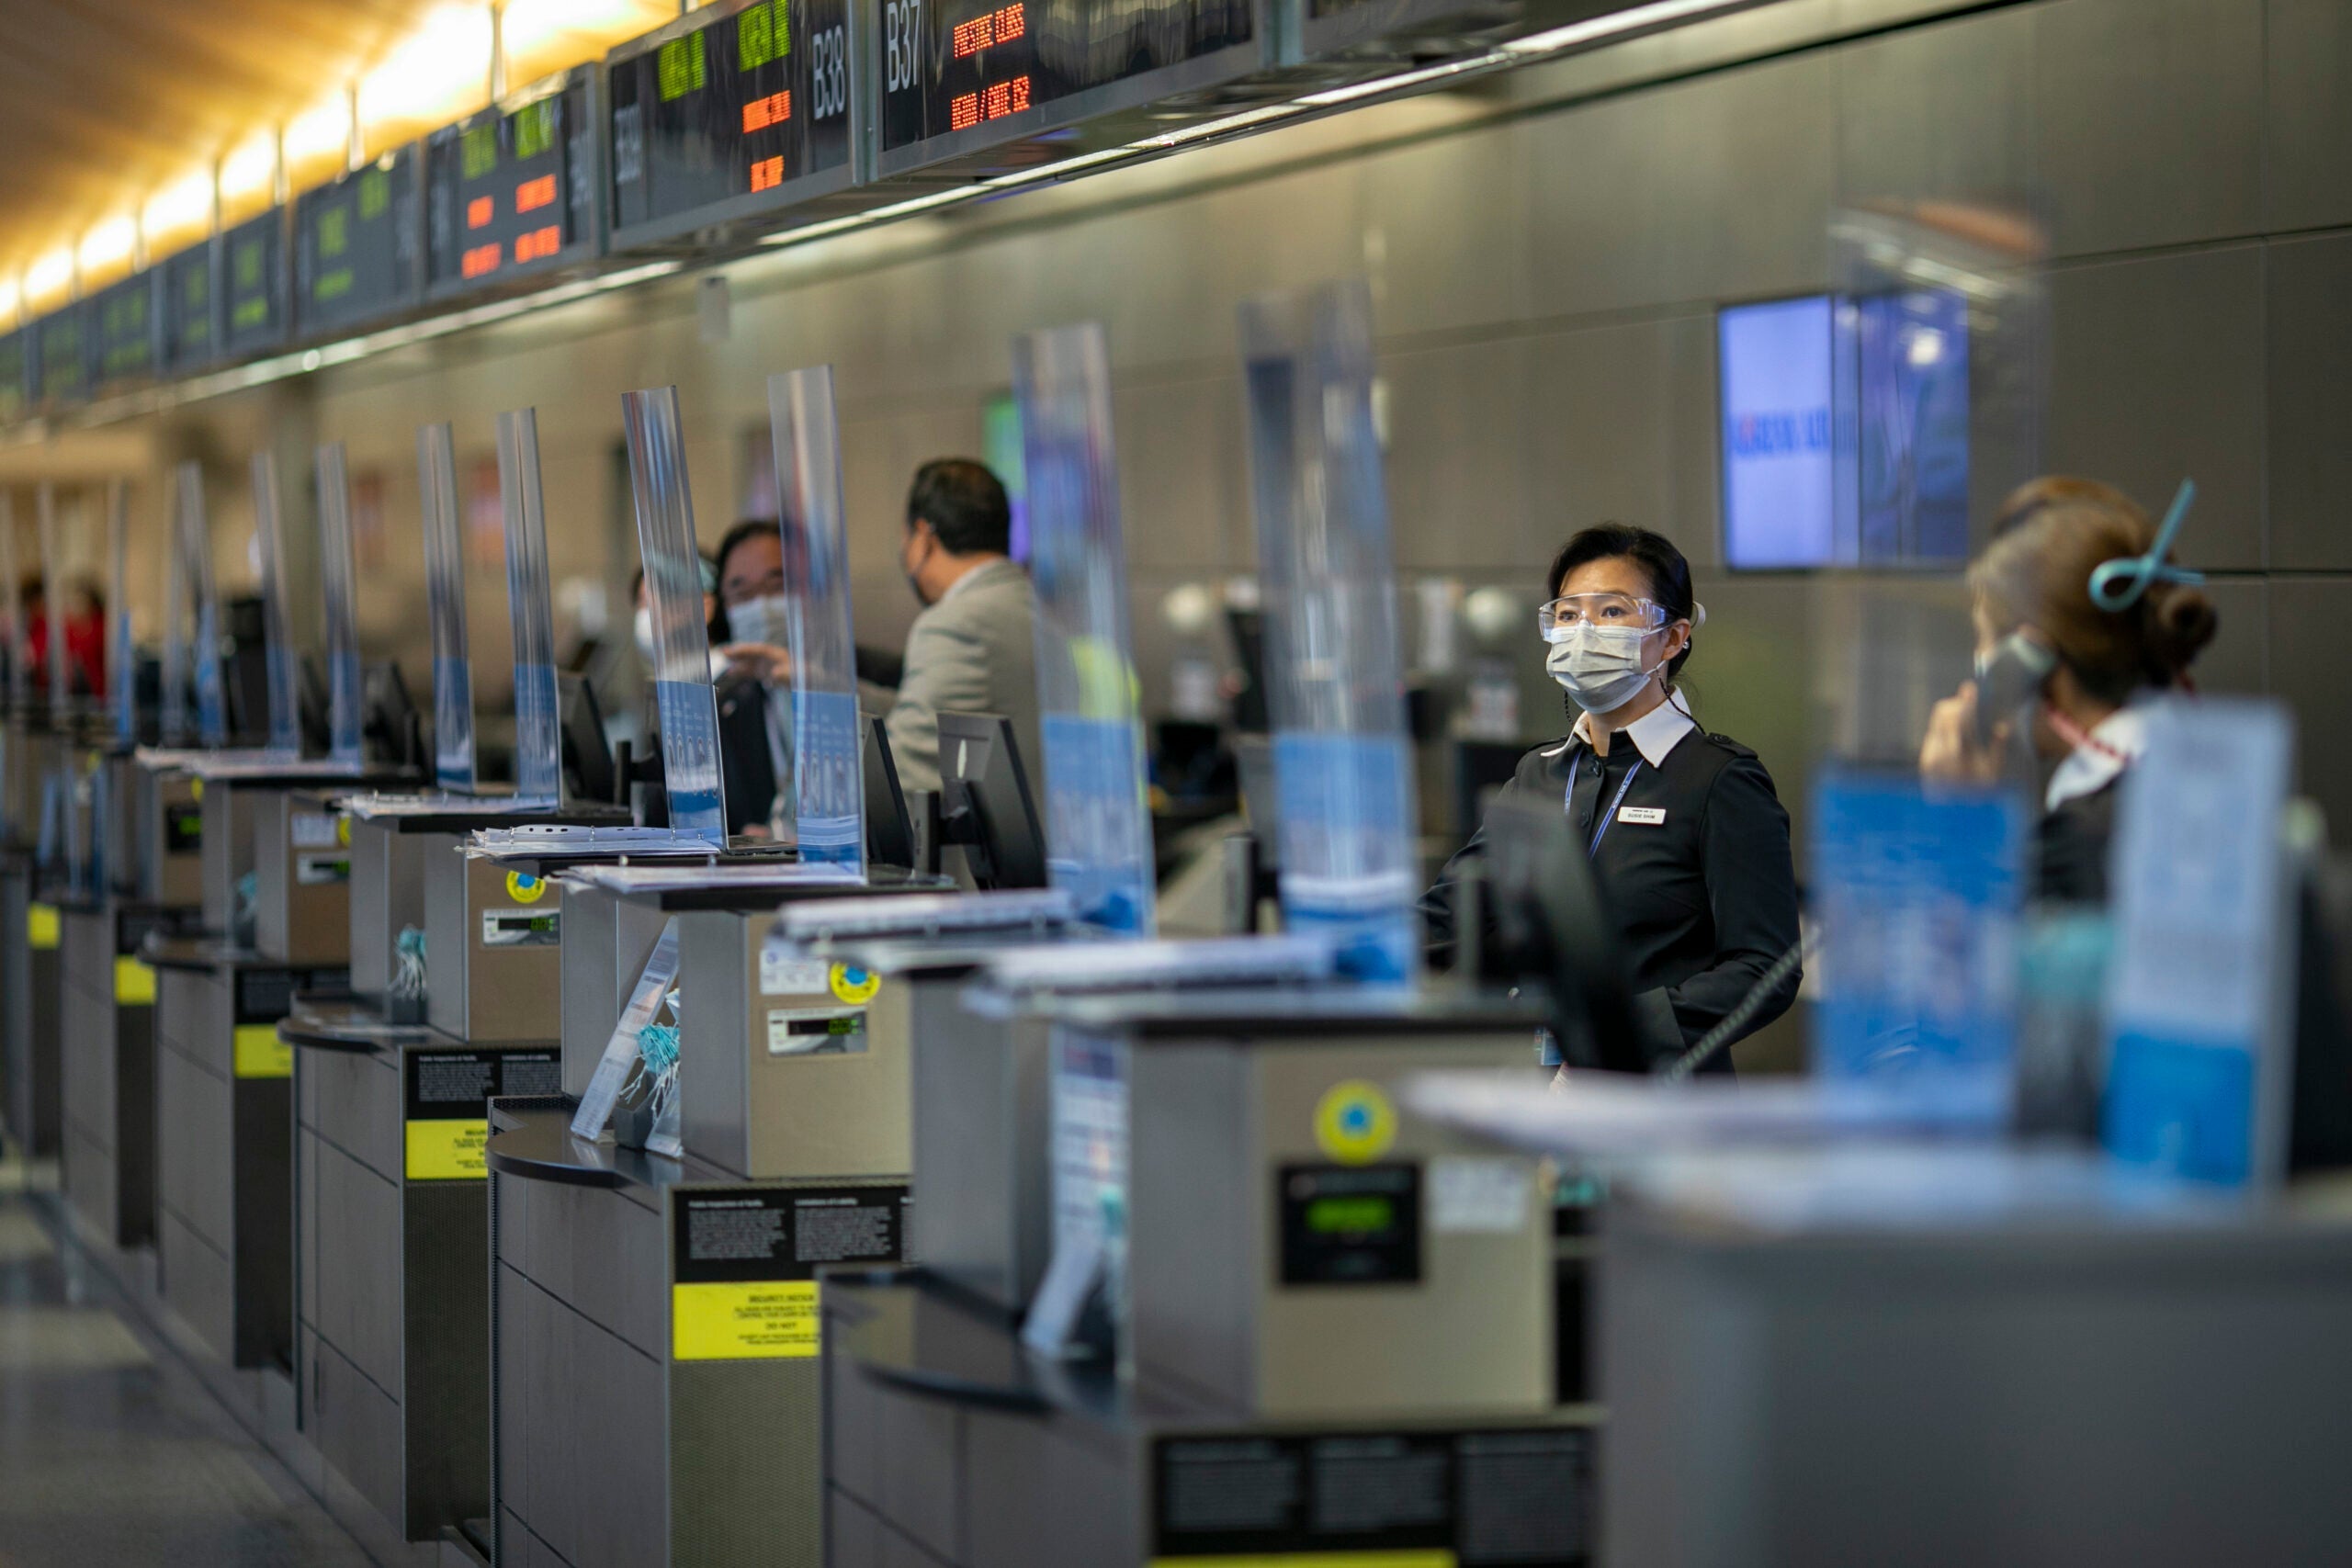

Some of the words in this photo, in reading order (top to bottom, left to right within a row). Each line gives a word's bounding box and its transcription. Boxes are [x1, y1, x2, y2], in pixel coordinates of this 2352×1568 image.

[812, 24, 846, 120] B38
[888, 0, 921, 93] B37
[749, 1294, 784, 1303] SECURITY
[786, 1293, 814, 1302] NOTICE
